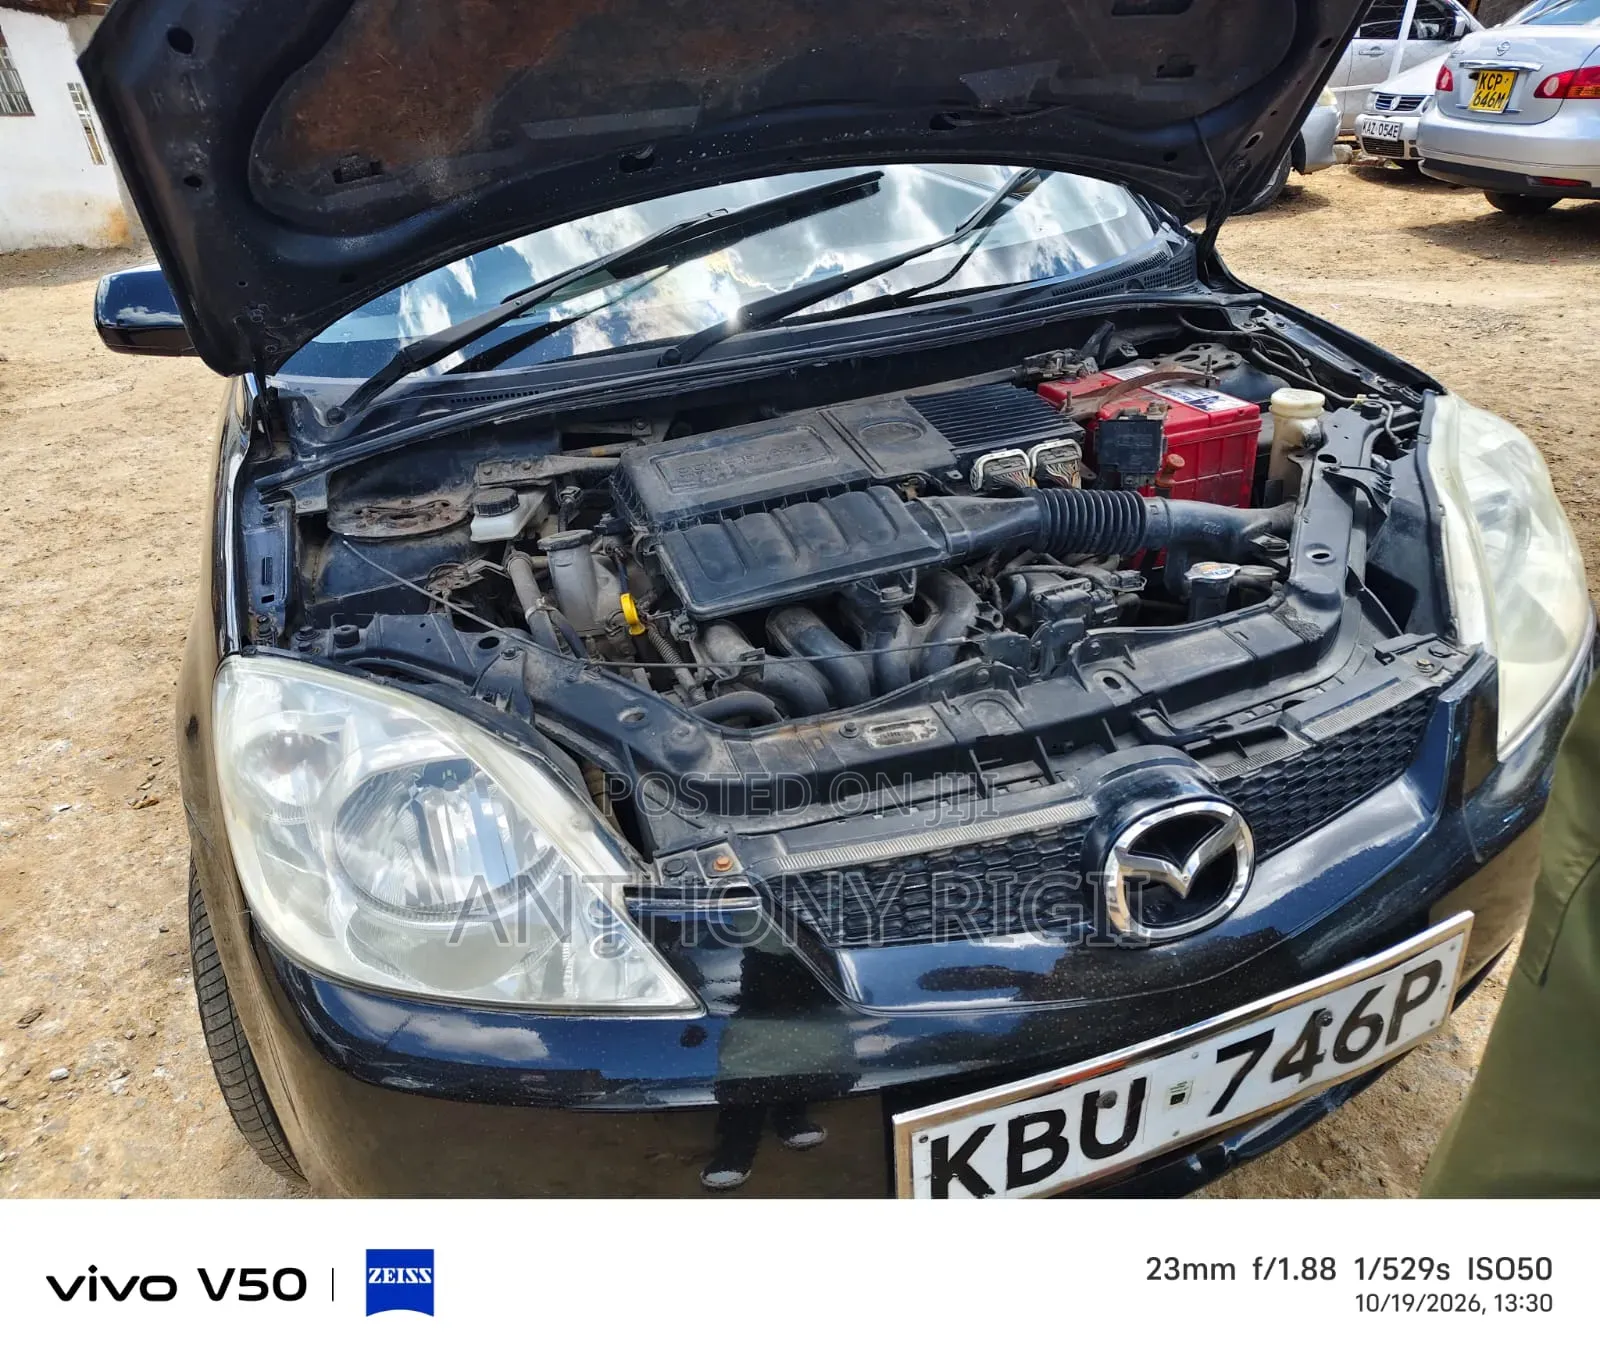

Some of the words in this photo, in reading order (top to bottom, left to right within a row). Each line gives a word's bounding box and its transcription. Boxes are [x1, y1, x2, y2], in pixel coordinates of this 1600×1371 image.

[1479, 70, 1503, 90] KCP
[1472, 90, 1507, 109] 646M
[1362, 119, 1376, 135] KAZ
[1378, 122, 1399, 138] 054E
[930, 1076, 1147, 1199] KBU
[1208, 959, 1443, 1117] 746P
